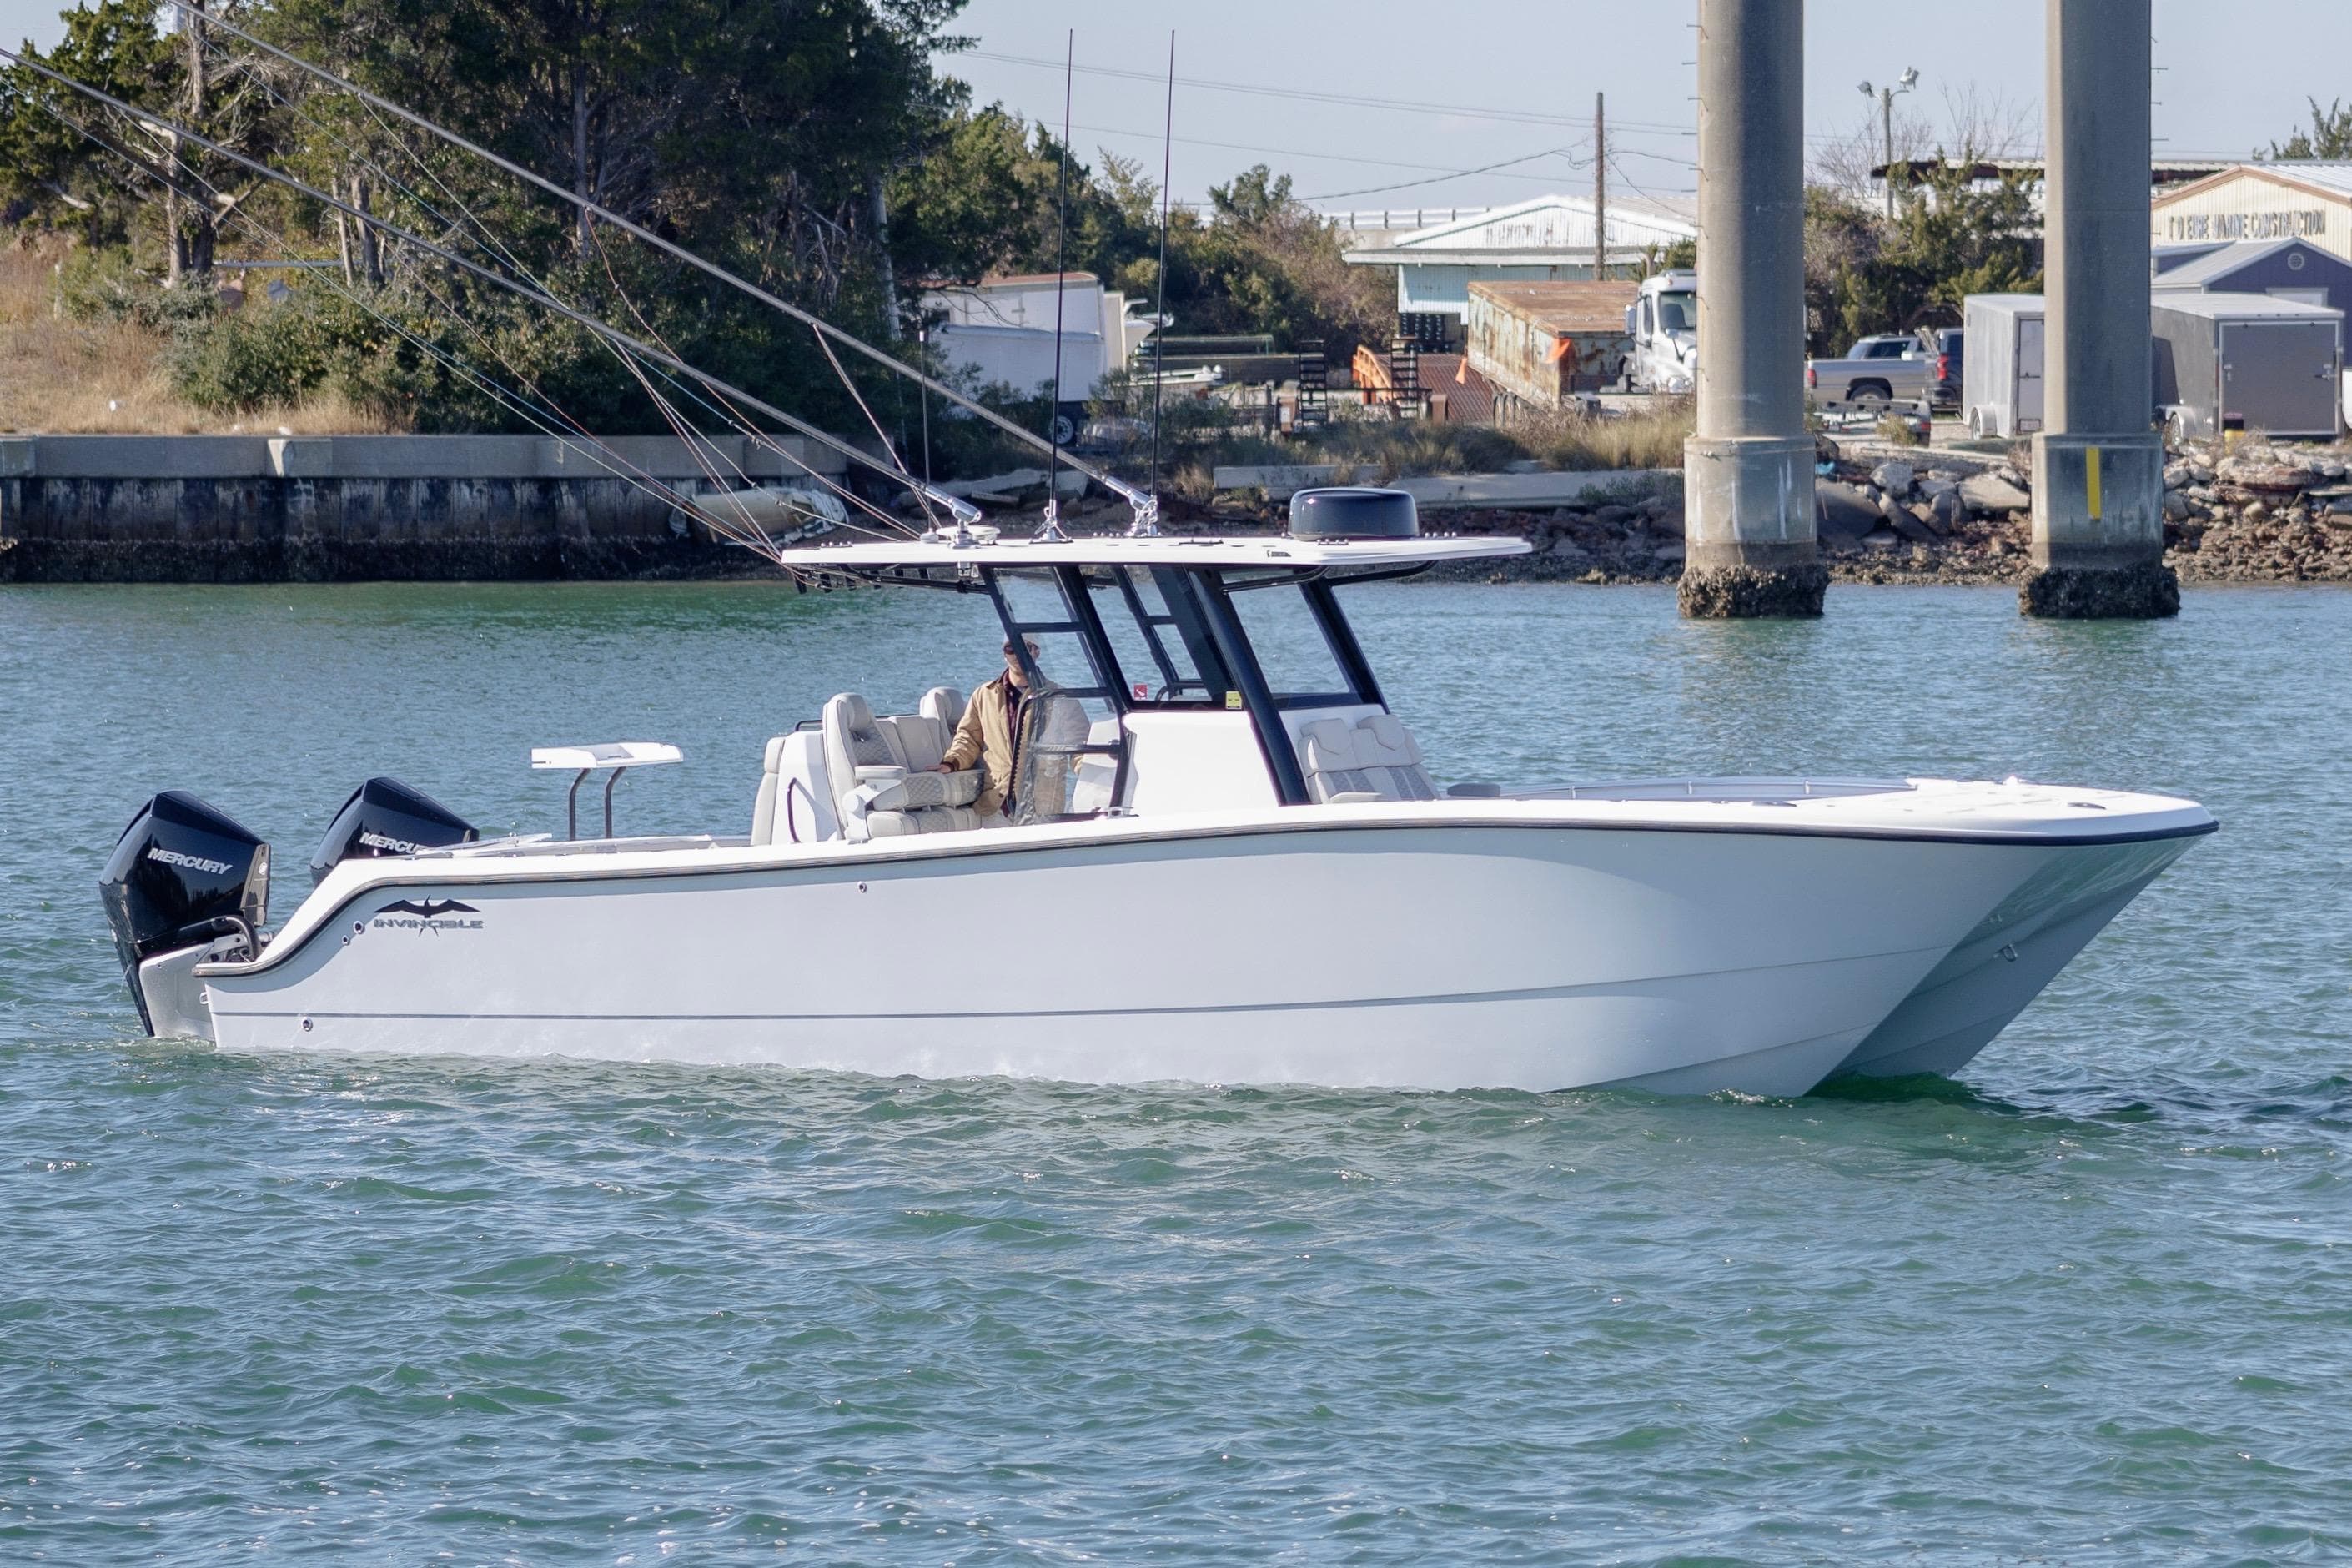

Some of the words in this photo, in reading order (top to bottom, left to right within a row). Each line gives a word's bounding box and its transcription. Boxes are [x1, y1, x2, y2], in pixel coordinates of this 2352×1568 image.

[2214, 214, 2249, 240] MARINE
[2251, 209, 2325, 239] CONSTRUCTION
[359, 832, 428, 854] MERCU
[147, 847, 233, 874] MERCURY
[374, 919, 484, 929] INVINCIBLE
